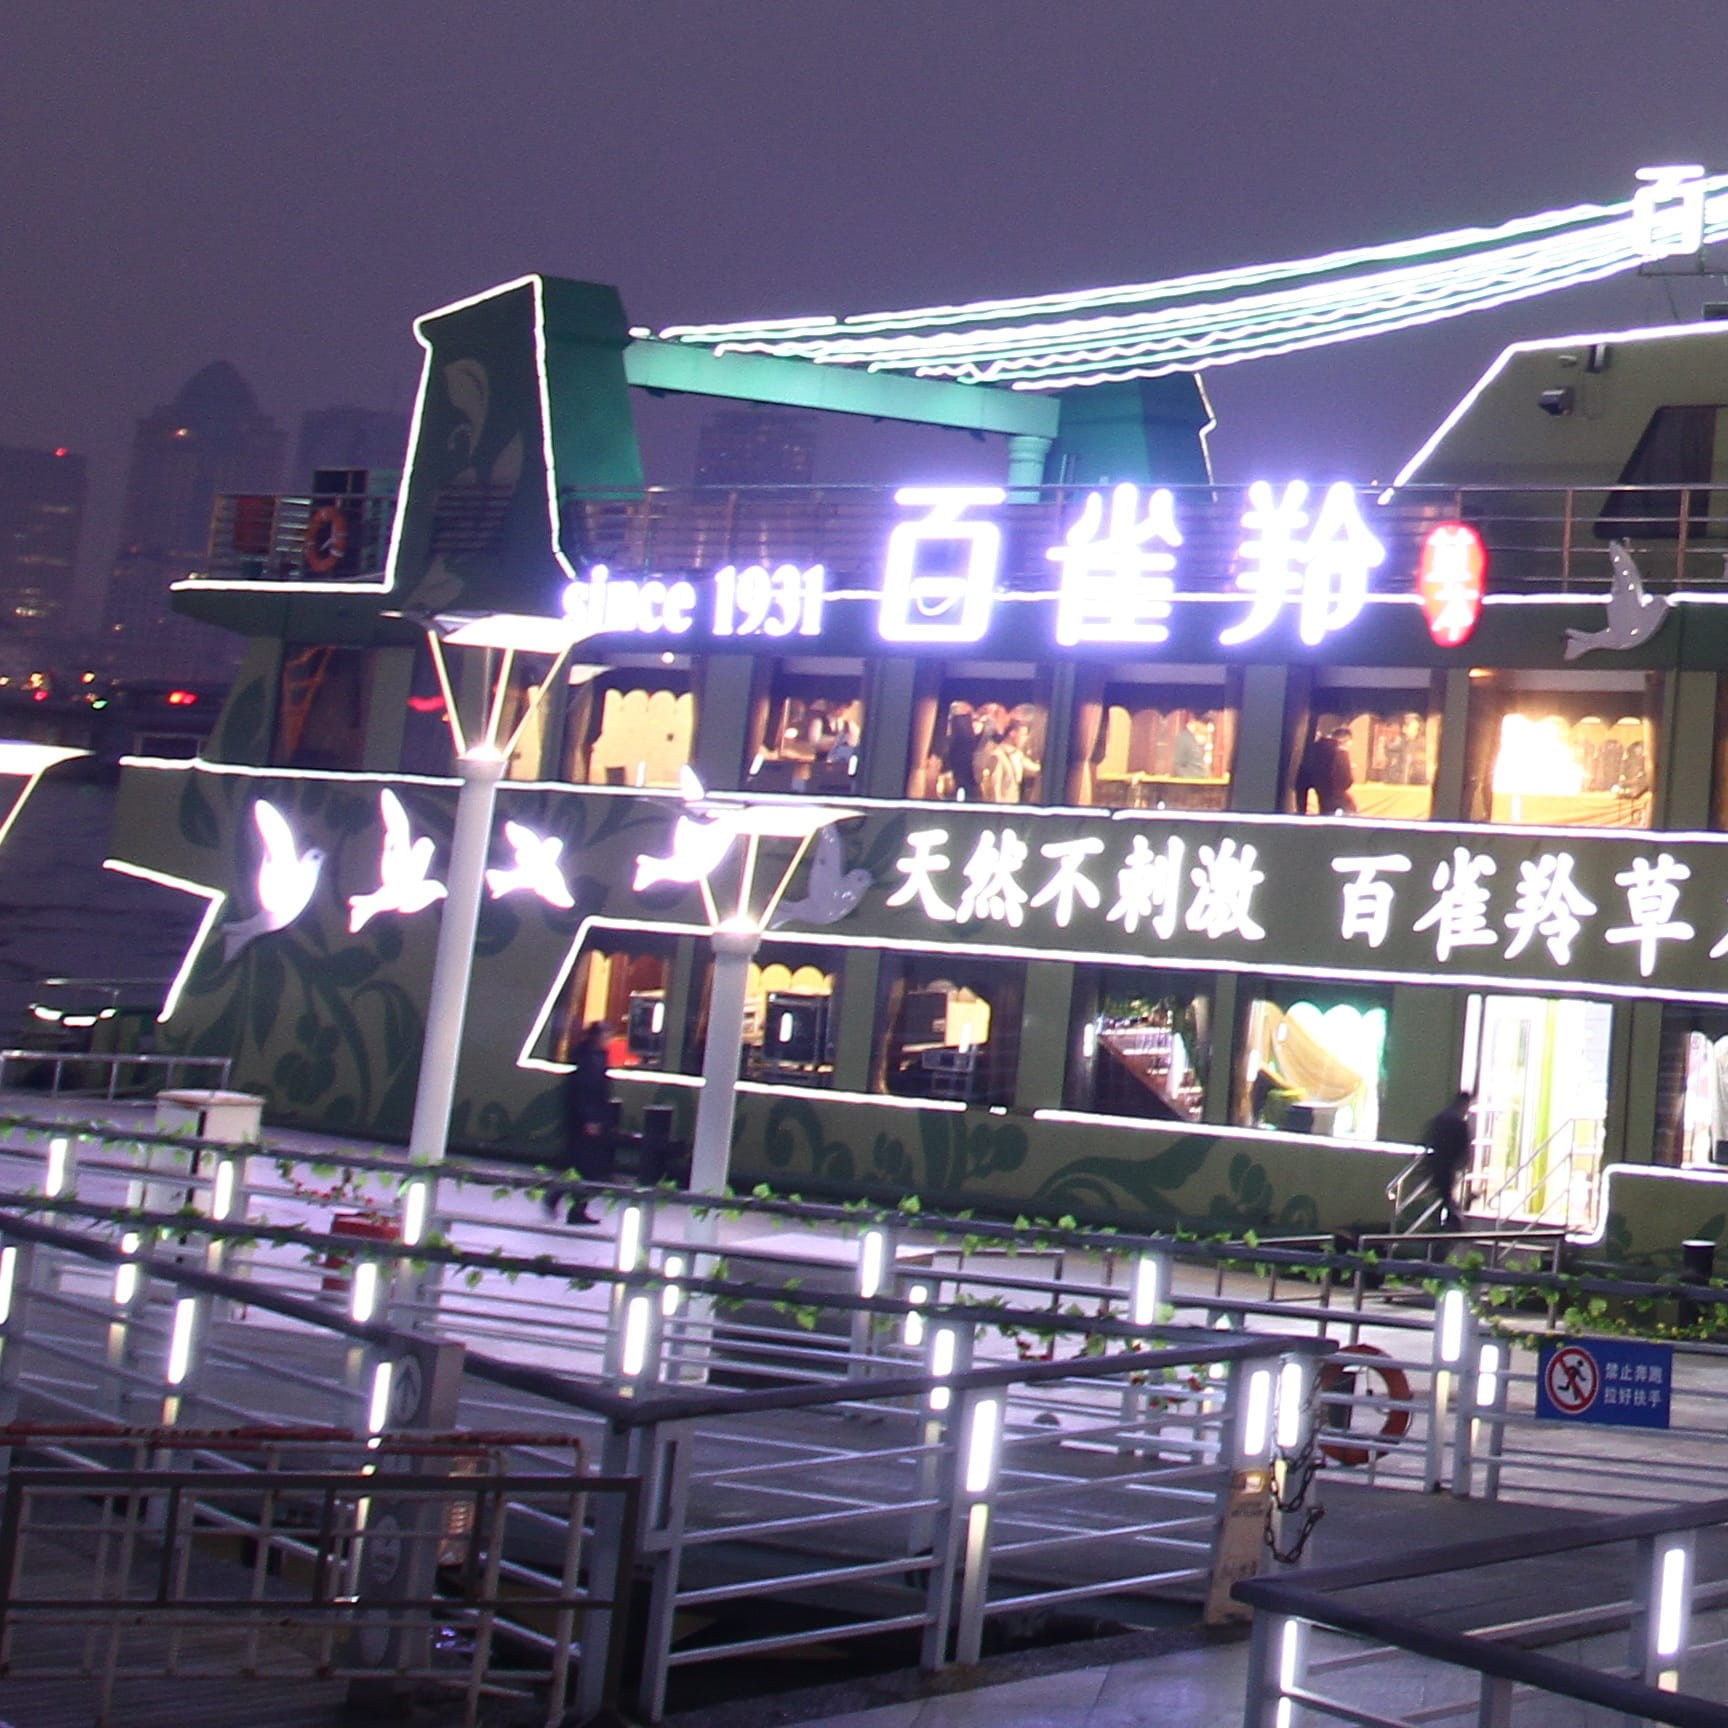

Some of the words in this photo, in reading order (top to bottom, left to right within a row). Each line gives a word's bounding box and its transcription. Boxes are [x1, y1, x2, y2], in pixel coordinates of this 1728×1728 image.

[562, 563, 697, 633] since
[712, 563, 825, 636] 1931
[878, 480, 1386, 646] 百雀羚
[886, 827, 1266, 941] 天然不刺激
